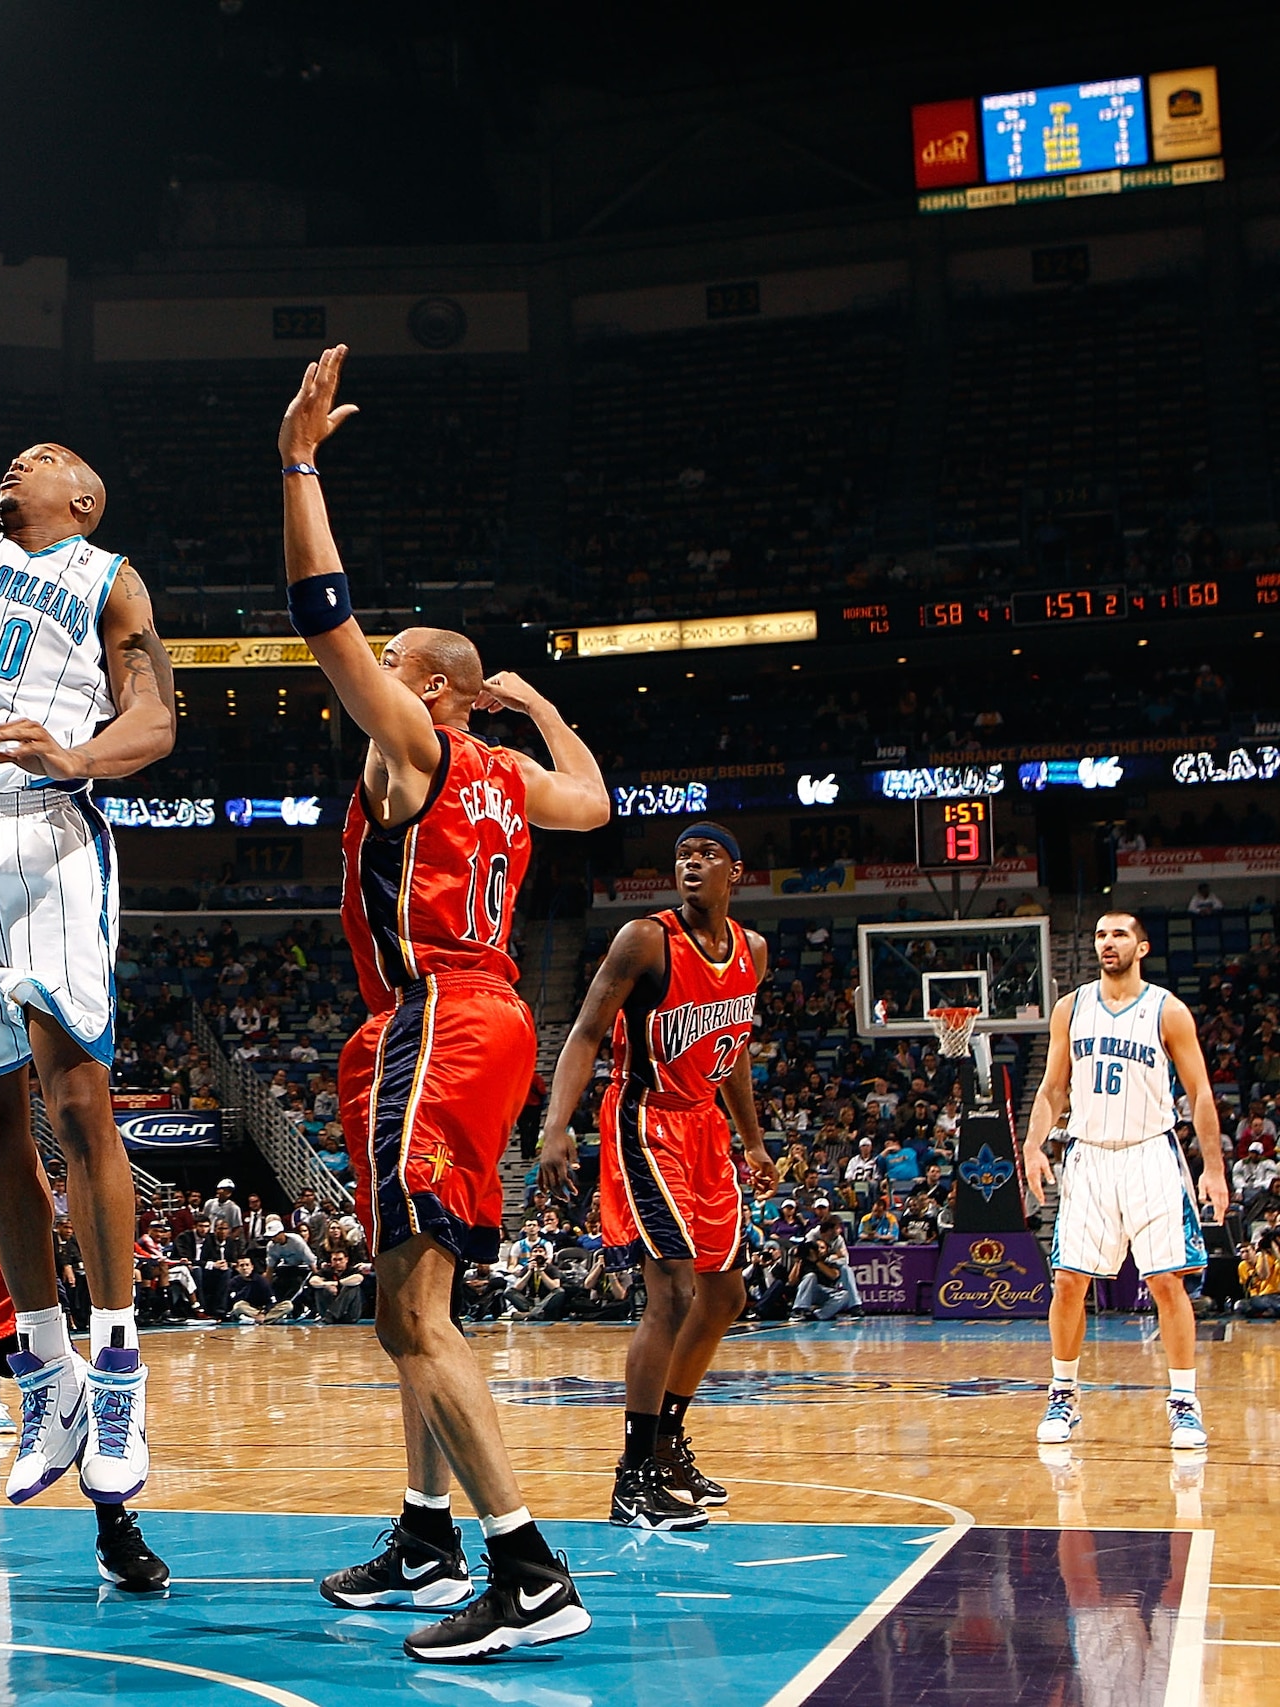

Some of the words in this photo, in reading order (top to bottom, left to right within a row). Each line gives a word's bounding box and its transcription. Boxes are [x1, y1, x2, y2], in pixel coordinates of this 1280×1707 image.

[1046, 591, 1091, 618] 1:57
[1105, 594, 1117, 616] 2
[1188, 582, 1218, 606] 60
[843, 604, 888, 620] HORNETS
[934, 603, 962, 627] 58
[582, 633, 621, 648] WHAT
[627, 631, 658, 645] CAN
[660, 626, 713, 642] BROWN
[719, 625, 738, 639] DO
[744, 623, 771, 636] FOR
[779, 618, 815, 633] YOU?
[870, 620, 890, 634] FLS
[243, 643, 317, 664] SUBWA
[928, 748, 1016, 765] INSURANCE
[1019, 743, 1077, 760] AGENCY
[1081, 740, 1105, 756] OF
[1108, 738, 1140, 754] THE
[1142, 735, 1218, 752] HORNETS
[717, 761, 786, 779] BENEFITS
[944, 802, 985, 823] 1:57
[946, 823, 980, 861] 13
[1149, 850, 1204, 865] TOYOTA
[659, 993, 758, 1065] WARRIORS
[1099, 1037, 1157, 1068] ORLEANS
[1093, 1061, 1124, 1096] 16
[133, 1123, 216, 1138] LIGHT
[938, 1279, 988, 1309] Crown
[973, 1279, 1045, 1311] Royal
